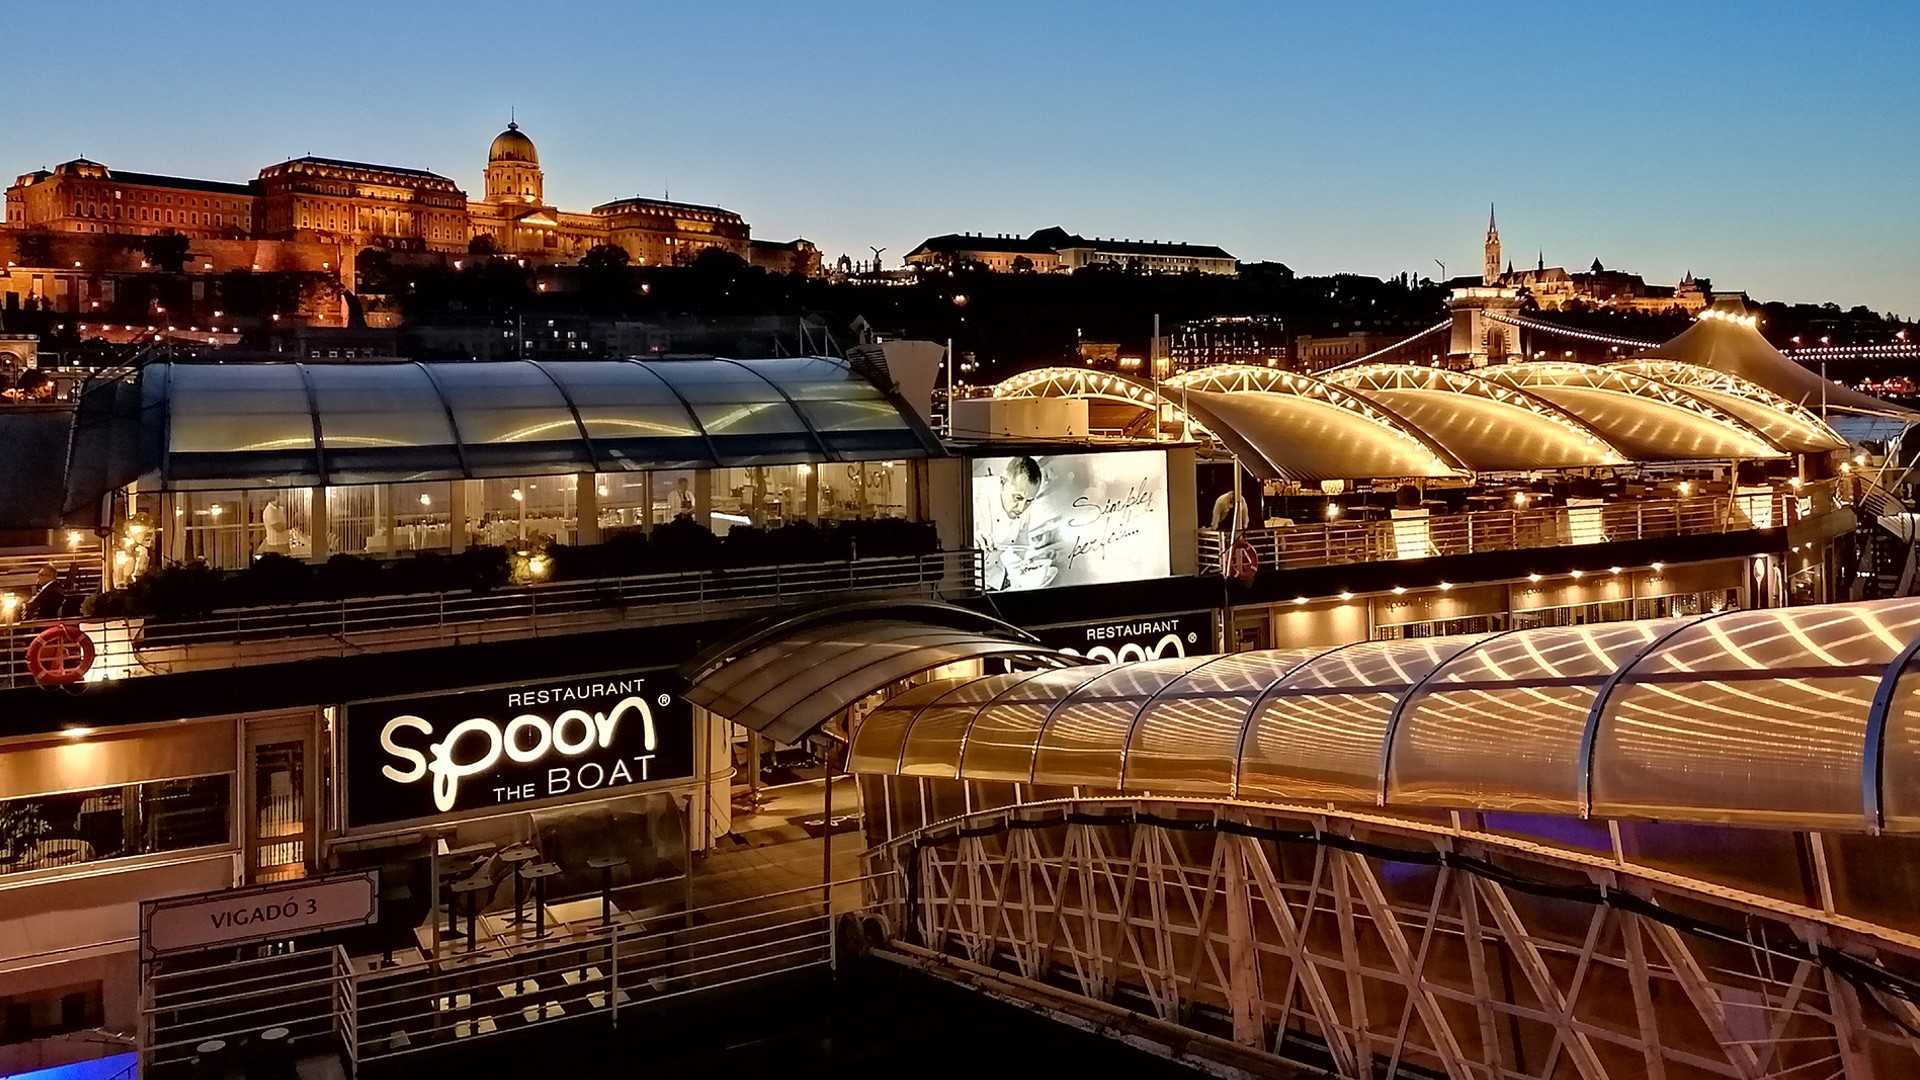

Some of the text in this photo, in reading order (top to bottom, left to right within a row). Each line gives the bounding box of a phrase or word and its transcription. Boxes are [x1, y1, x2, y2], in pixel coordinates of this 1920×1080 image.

[1086, 619, 1179, 641] RESTAURANT
[508, 678, 646, 707] RESTAURANT
[493, 754, 656, 802] THE BOAT
[210, 896, 318, 929] VIGADÓ 3
